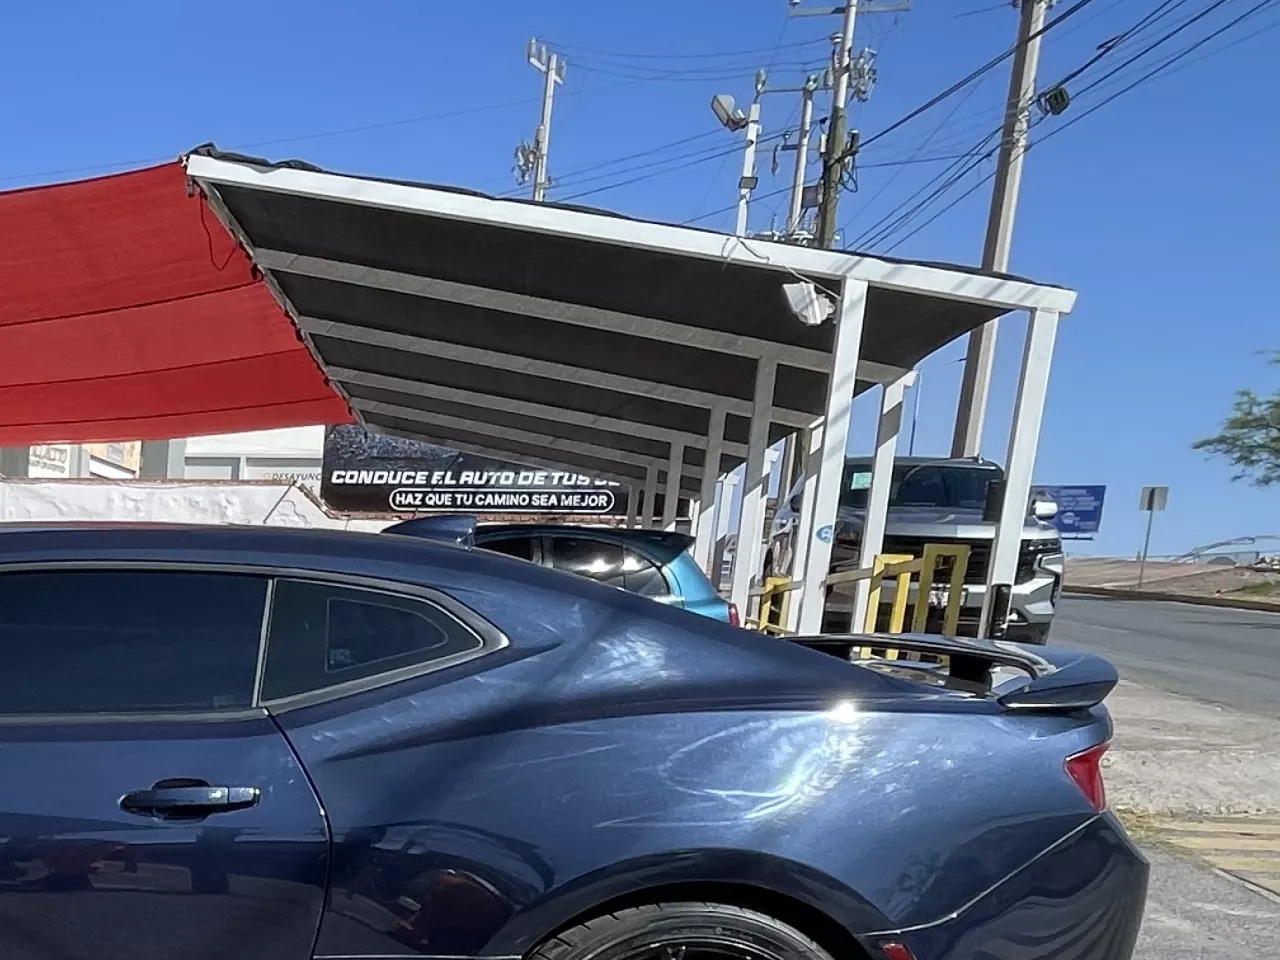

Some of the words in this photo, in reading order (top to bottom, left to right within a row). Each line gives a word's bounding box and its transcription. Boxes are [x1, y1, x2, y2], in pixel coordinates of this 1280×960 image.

[331, 470, 428, 484] CONDUCE
[431, 471, 456, 485] EL
[517, 471, 548, 485] DE
[551, 471, 591, 485] TUS
[395, 493, 423, 505] HAZ
[425, 493, 455, 506] QUE
[455, 494, 473, 505] TU
[475, 494, 530, 506] CAMINO
[531, 495, 558, 506] SEA
[560, 495, 608, 507] MEJOR
